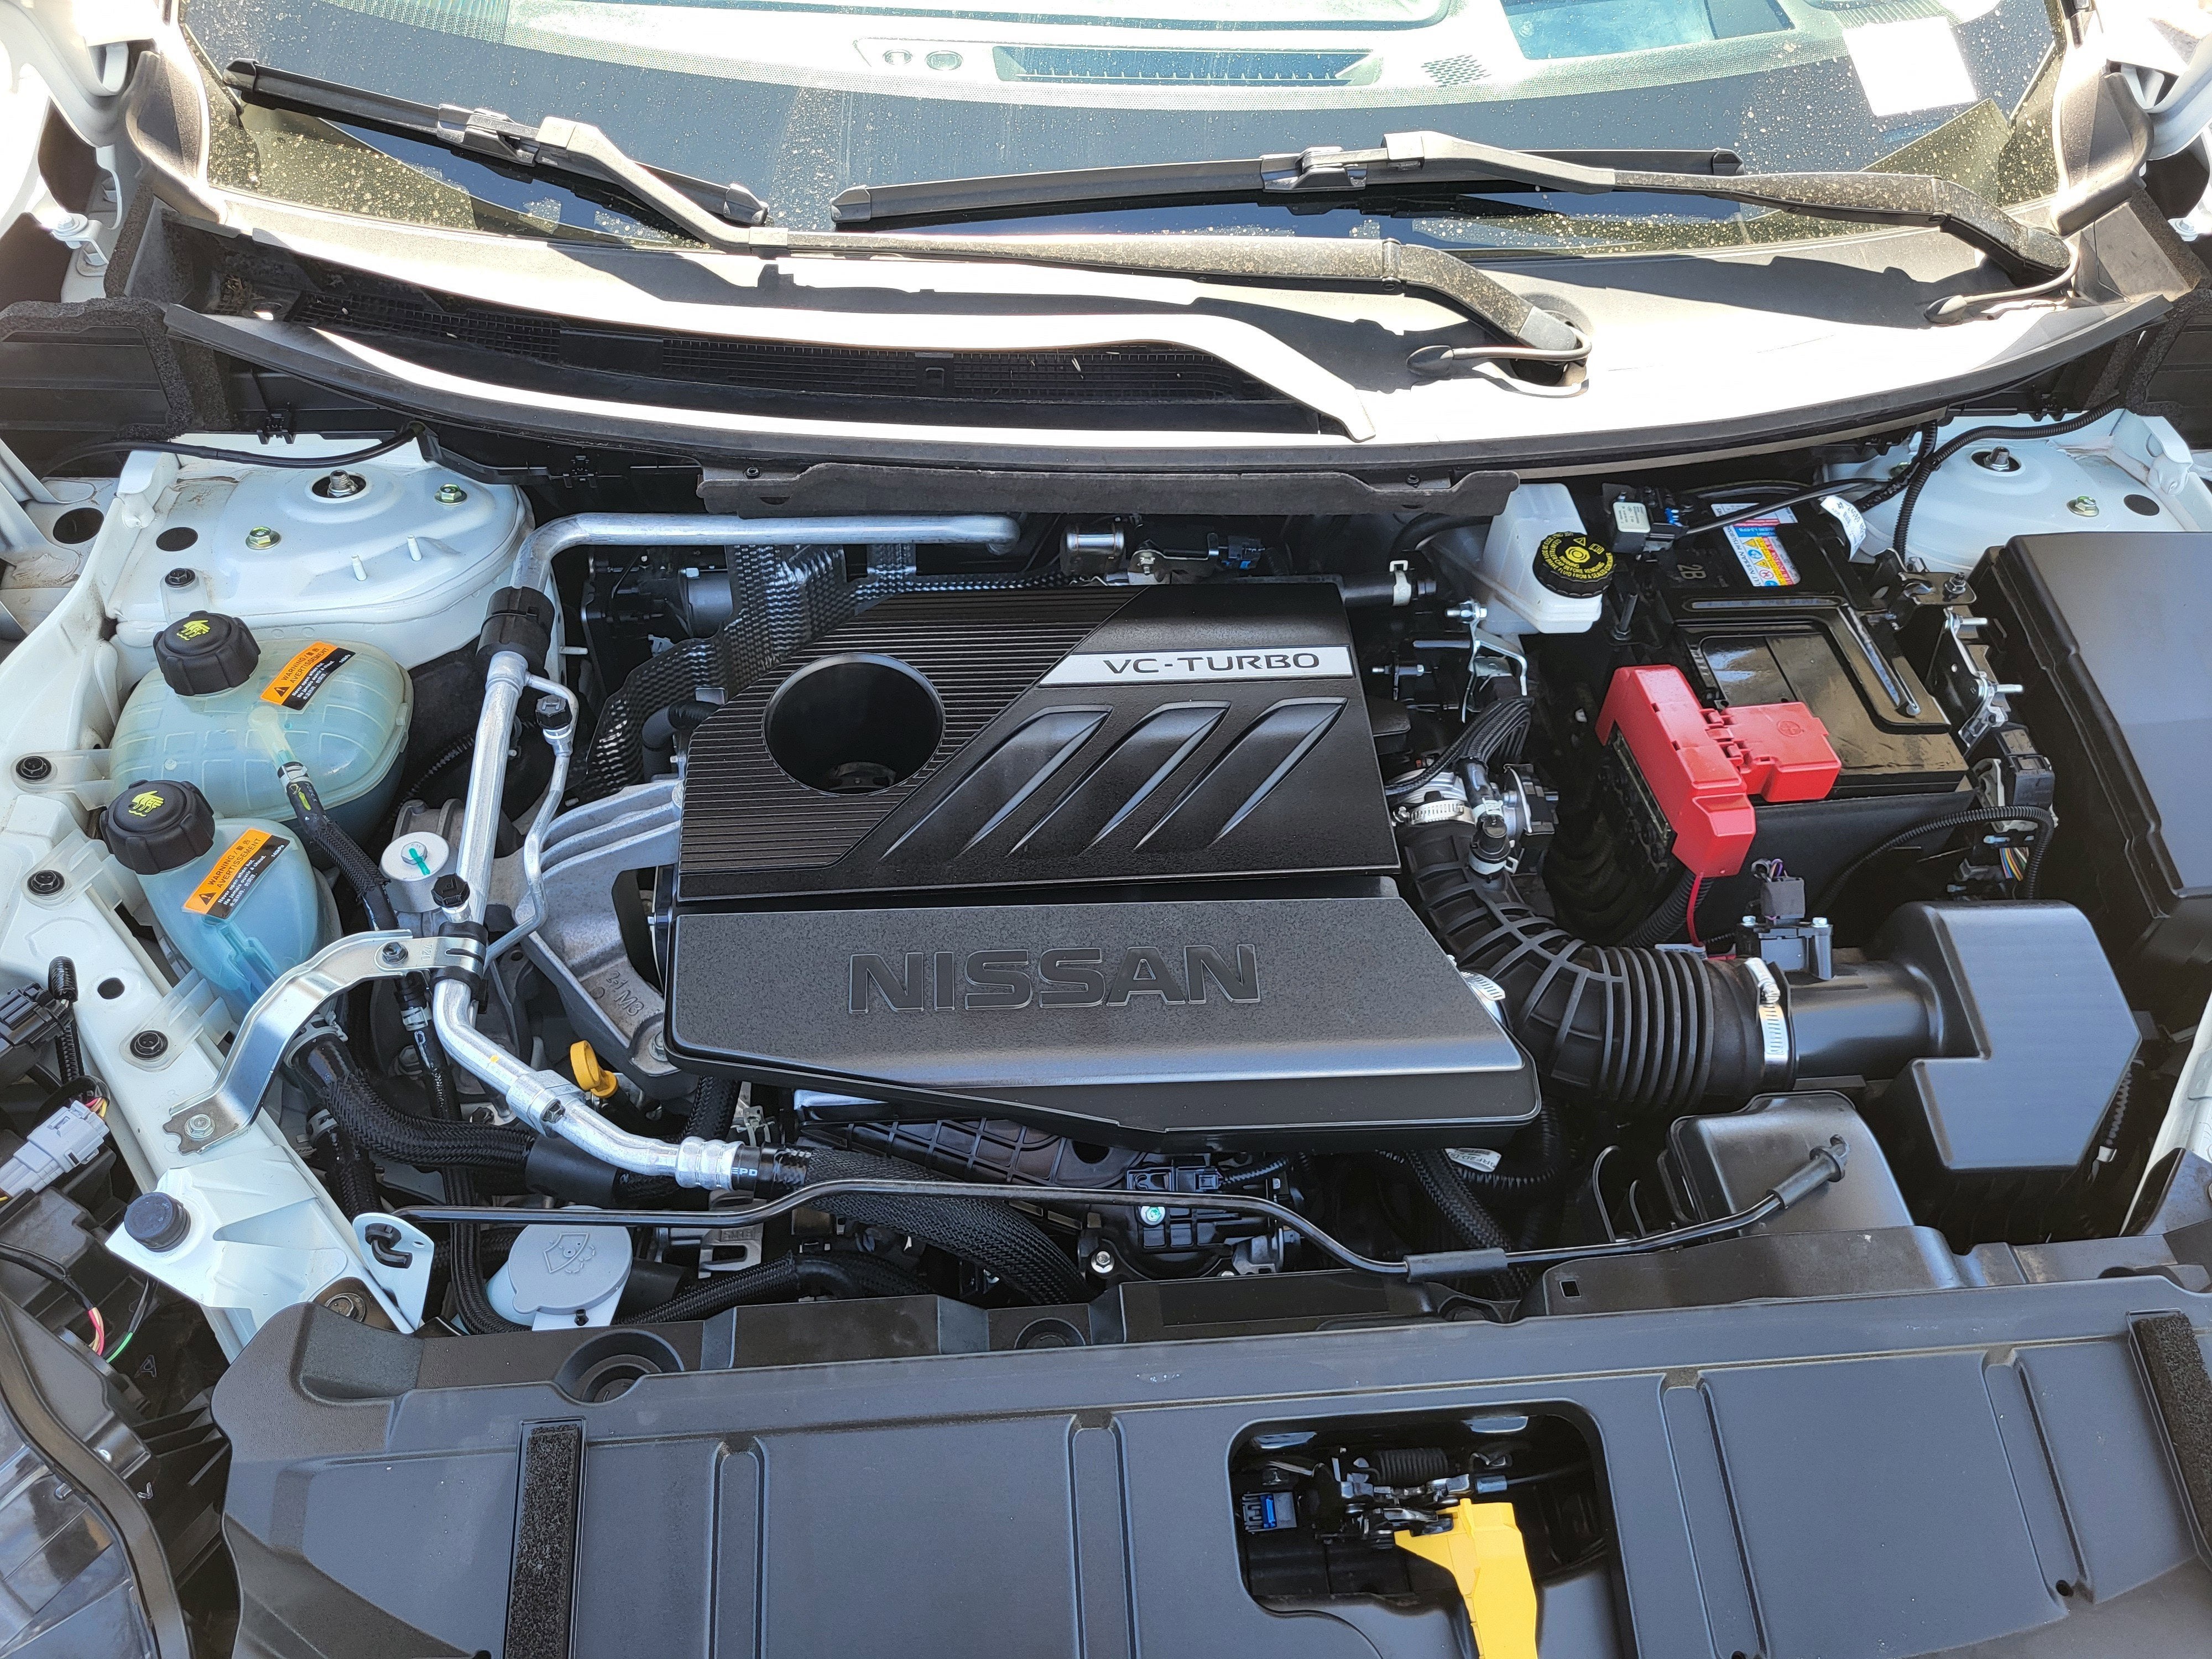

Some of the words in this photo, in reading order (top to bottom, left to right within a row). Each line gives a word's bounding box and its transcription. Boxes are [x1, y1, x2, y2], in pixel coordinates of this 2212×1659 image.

[1558, 567, 1572, 577] FLUID
[1563, 565, 1584, 574] BEFORE
[1676, 564, 1707, 580] 2B
[1739, 551, 1756, 575] NISSAN
[281, 658, 306, 681] WARNING
[290, 648, 329, 684] AVERTISSEMENT
[1102, 653, 1320, 674] VC-TURBO
[207, 854, 236, 886] WARNING
[216, 838, 262, 889] AVERTISSEMENT
[218, 890, 230, 903] Never
[229, 879, 239, 891] open
[237, 867, 248, 879] when
[223, 897, 231, 905] Ne
[229, 883, 242, 898] jamais
[241, 870, 252, 884] ouvrir
[847, 943, 1261, 1015] NISSAN
[614, 989, 645, 1016] M3
